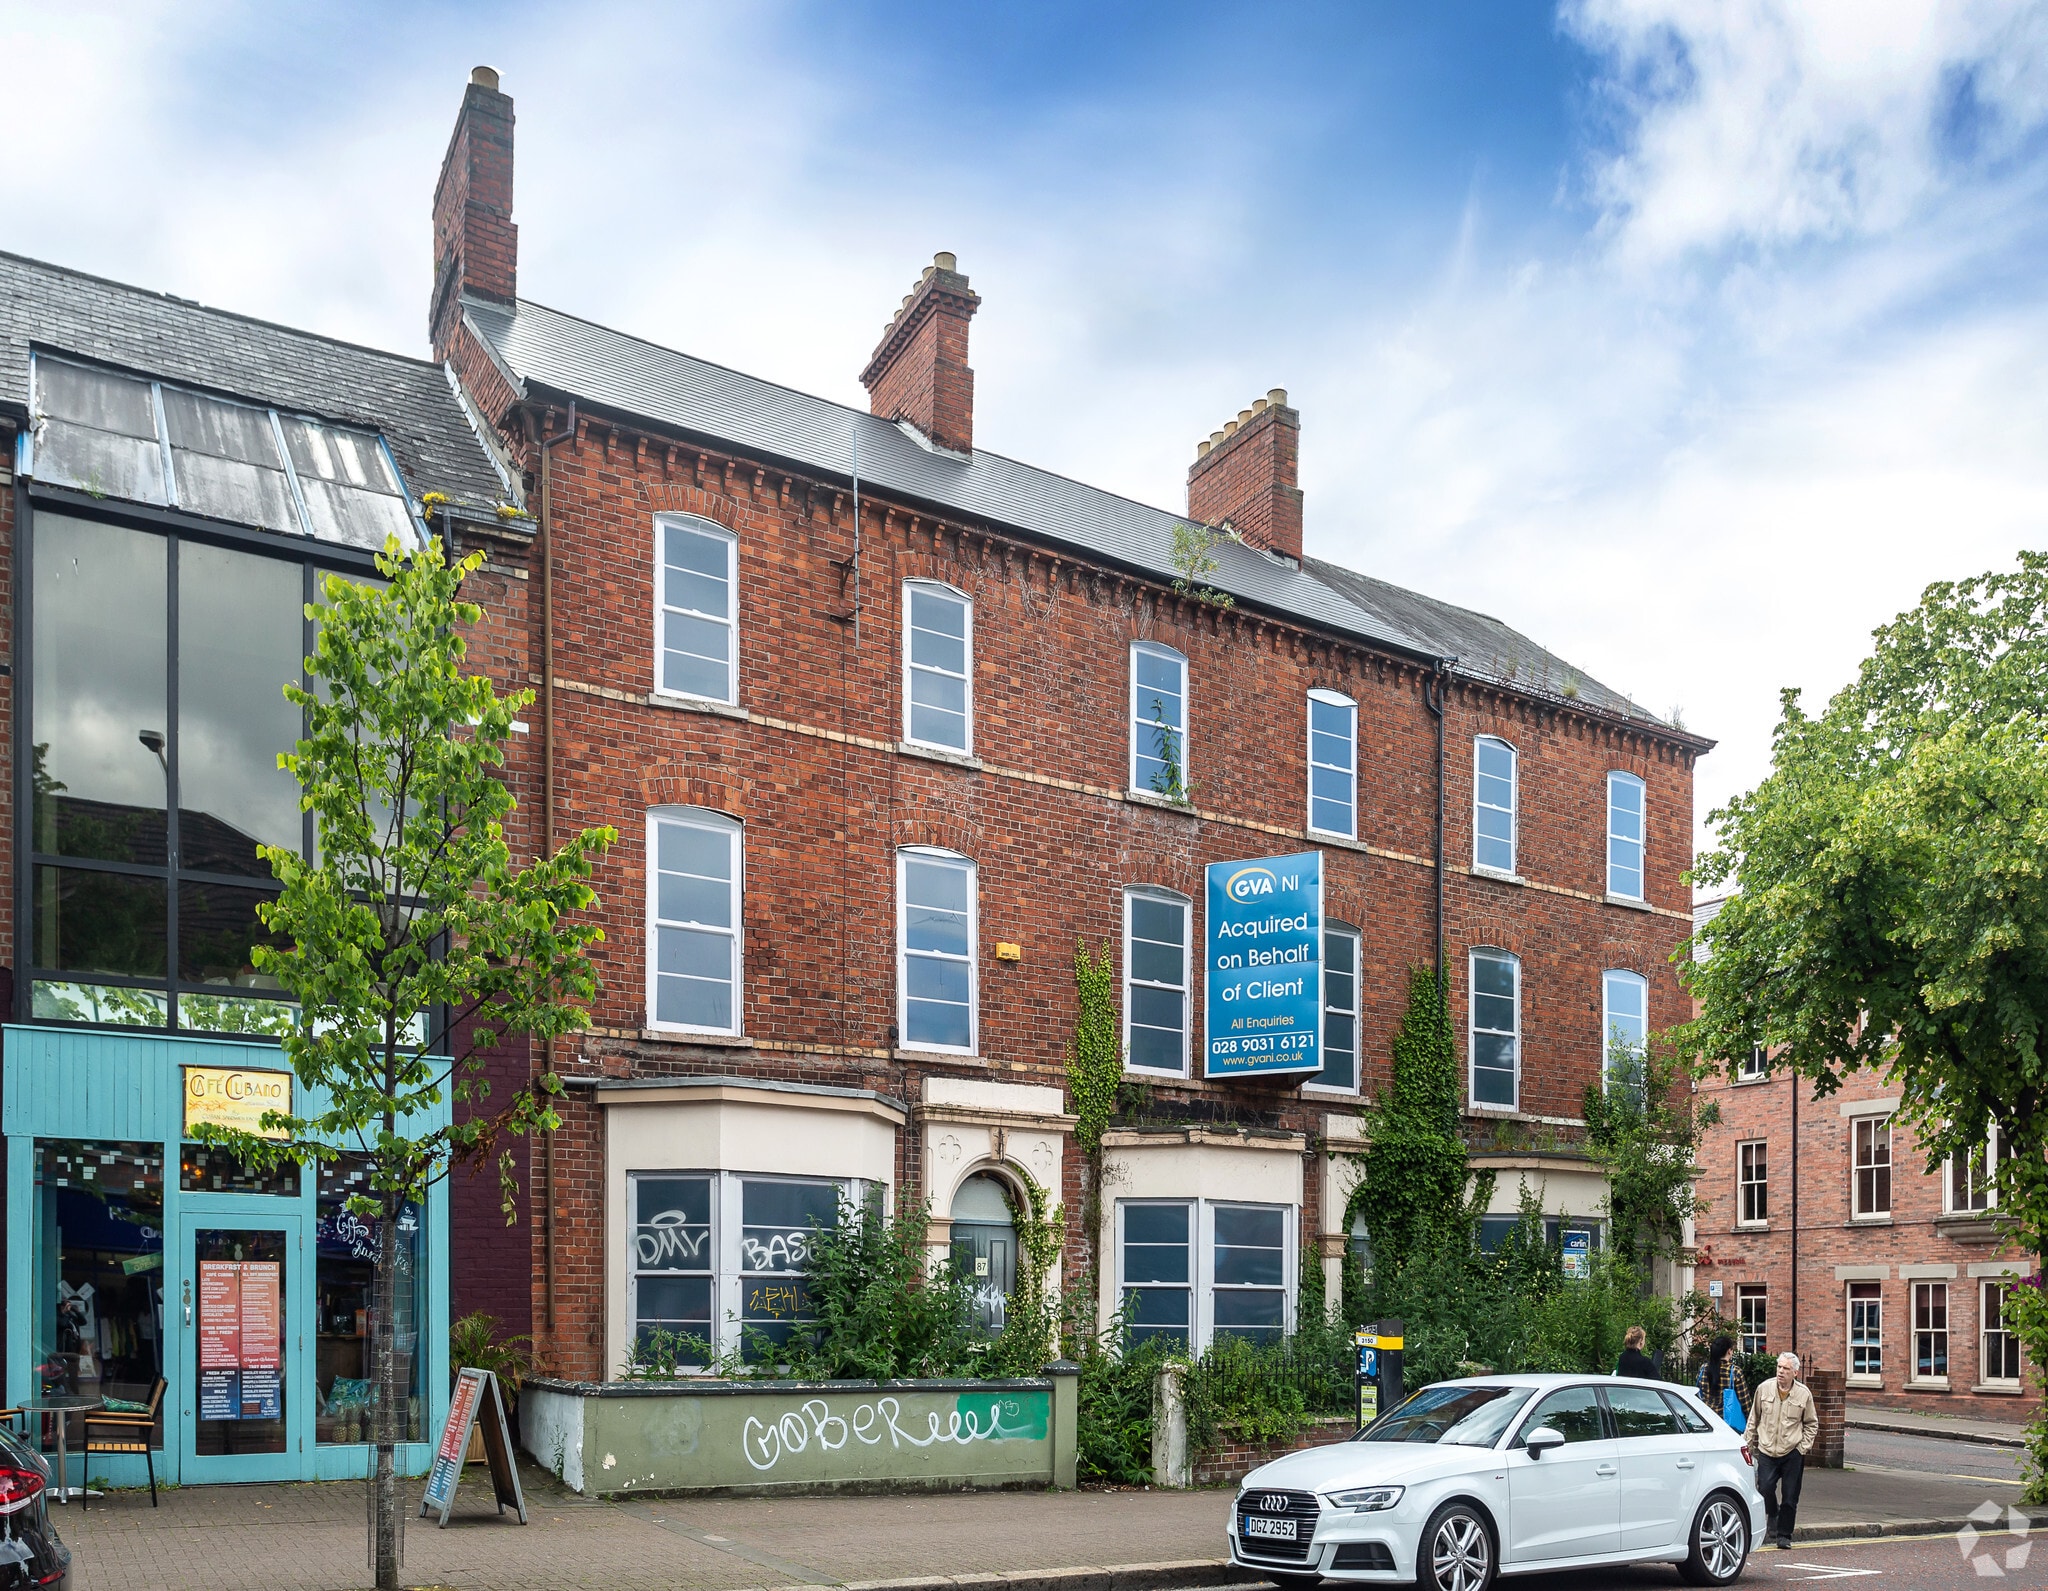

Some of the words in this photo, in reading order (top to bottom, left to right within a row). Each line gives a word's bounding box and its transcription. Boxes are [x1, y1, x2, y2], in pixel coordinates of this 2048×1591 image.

[1235, 878, 1274, 897] GVA
[1282, 874, 1299, 892] NI
[1217, 912, 1308, 939] Acquired
[1217, 954, 1242, 970] on
[1248, 943, 1309, 967] Behalf
[1221, 983, 1242, 1002] of
[1246, 977, 1304, 999] Client
[1230, 1017, 1244, 1030] All
[1246, 1014, 1295, 1030] Enquiries
[1212, 1040, 1238, 1055] 028
[1241, 1037, 1274, 1052] 9031
[1280, 1034, 1314, 1050] 6121
[1222, 1050, 1304, 1067] www.gvani.co.uk
[976, 1262, 987, 1272] 87
[1250, 1518, 1268, 1534] DGZ
[1269, 1520, 1295, 1536] 2952
